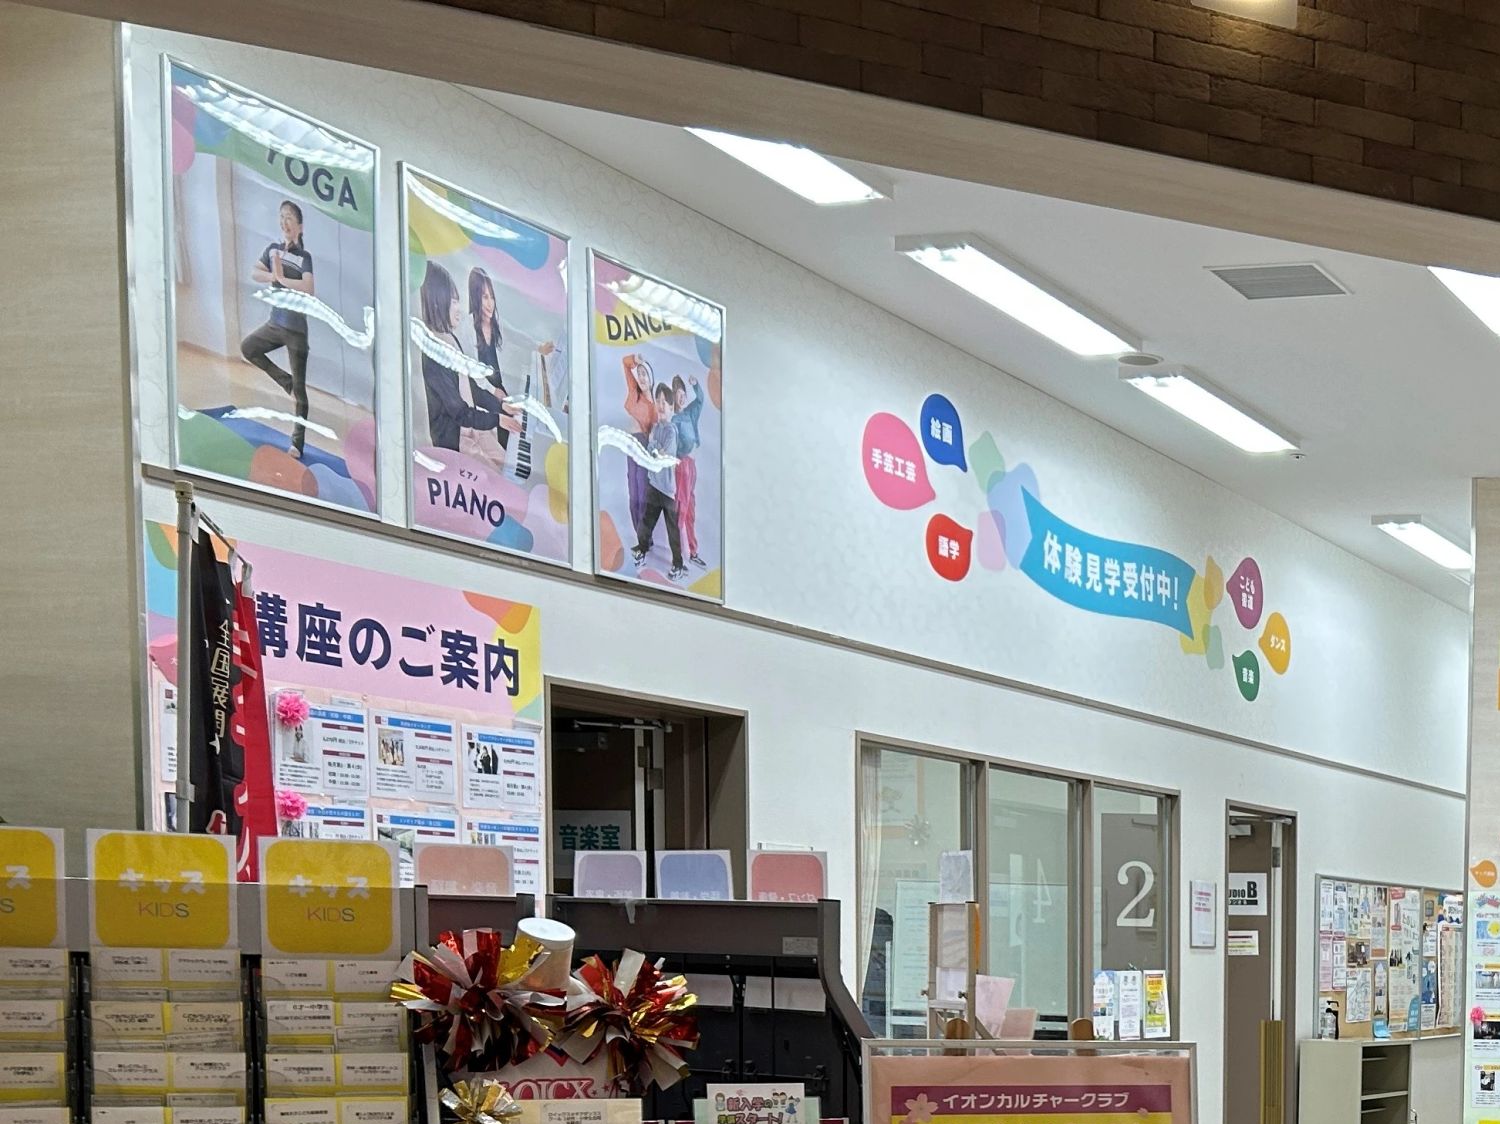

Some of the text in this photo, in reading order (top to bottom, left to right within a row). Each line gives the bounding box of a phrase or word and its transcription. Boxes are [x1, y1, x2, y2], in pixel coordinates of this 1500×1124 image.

[871, 448, 917, 484] 手芸工芸
[427, 476, 506, 528] PIANO
[937, 533, 961, 561] 語学
[1041, 529, 1181, 611] 体験見学受付中!
[255, 591, 520, 697] 講座のご案内
[1269, 634, 1287, 653] ダンス
[558, 823, 622, 851] 音楽室
[1116, 860, 1156, 928] 2
[1247, 881, 1258, 898] B
[139, 902, 190, 919] KIDS
[307, 906, 355, 923] KIDS
[500, 1080, 593, 1100] OICX
[942, 1092, 1130, 1110] イオンカルチャークラブ
